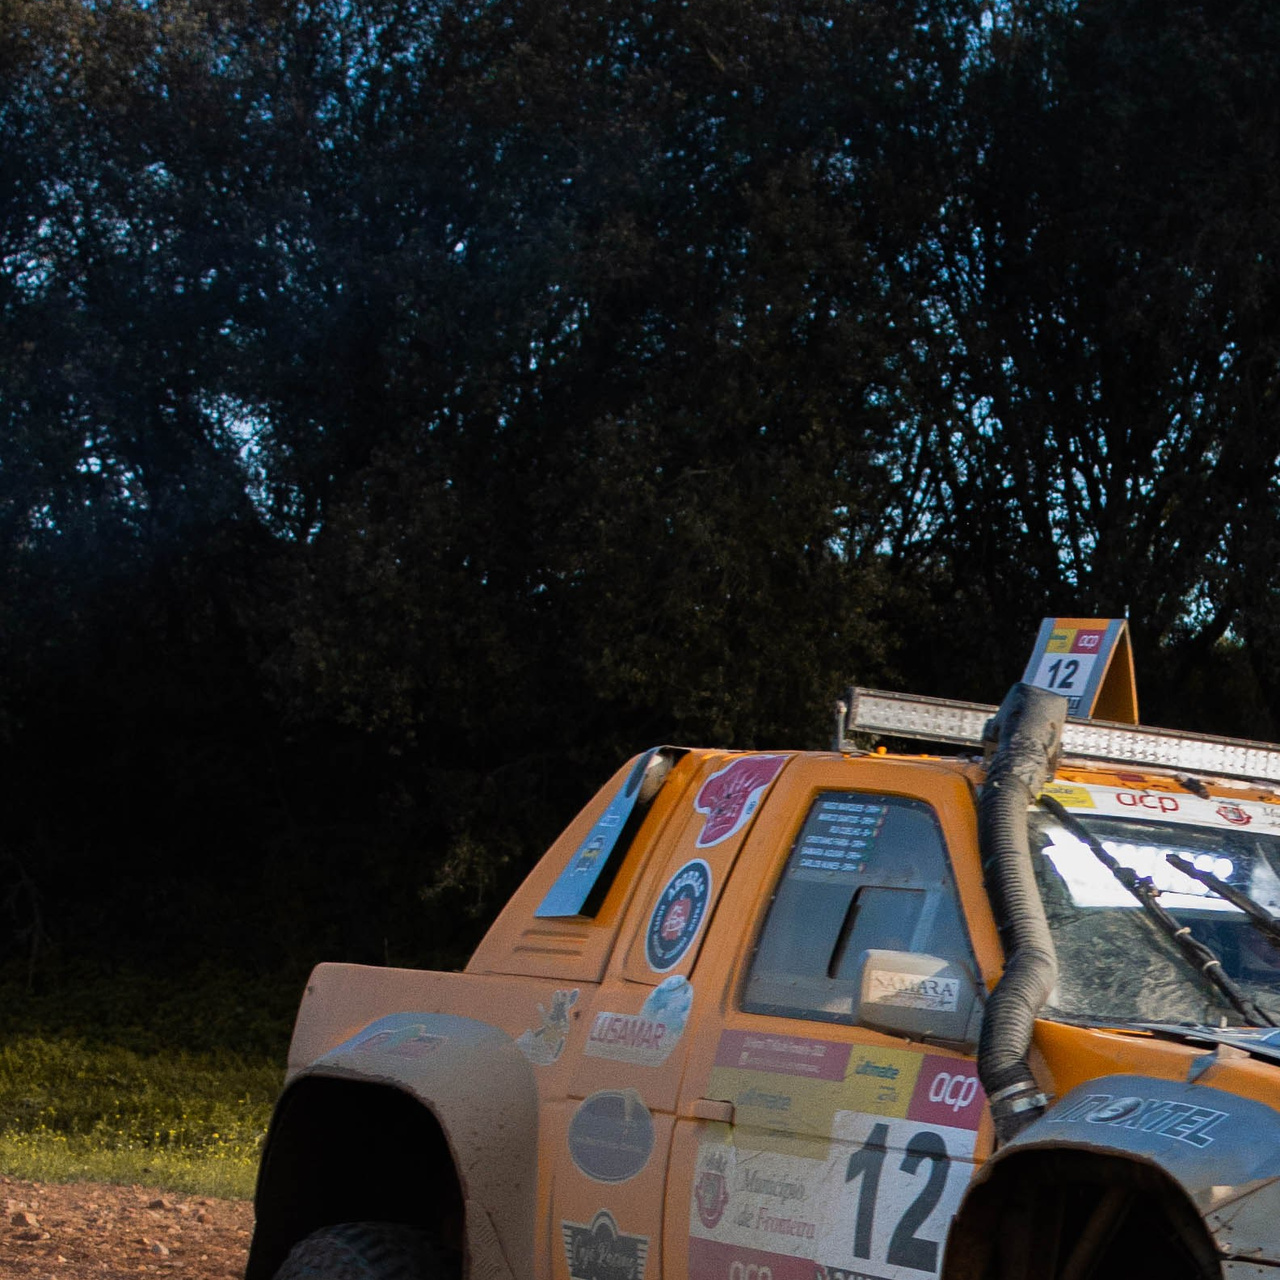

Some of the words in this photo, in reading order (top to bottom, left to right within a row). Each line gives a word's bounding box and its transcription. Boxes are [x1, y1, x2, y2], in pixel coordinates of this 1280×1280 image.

[1048, 658, 1080, 689] 12
[1115, 792, 1179, 813] acp
[929, 1072, 979, 1112] acp
[845, 1122, 952, 1274] 12
